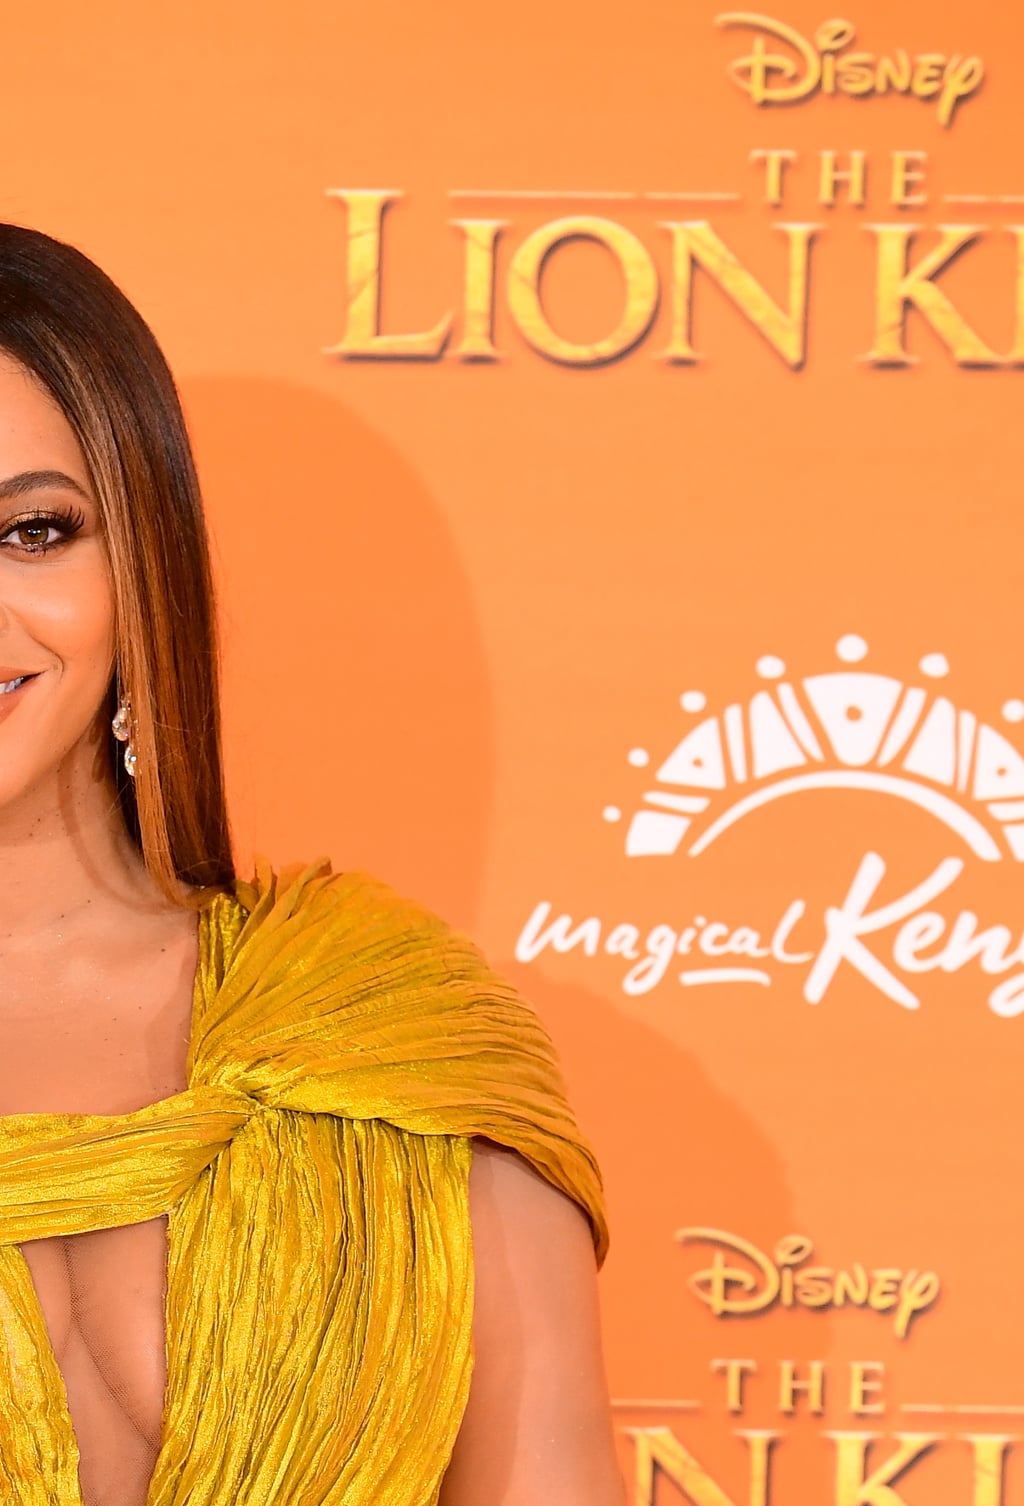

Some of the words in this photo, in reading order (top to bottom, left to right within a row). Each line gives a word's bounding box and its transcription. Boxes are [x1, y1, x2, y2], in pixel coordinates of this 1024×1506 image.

[749, 149, 928, 207] THE
[322, 189, 824, 371] LION
[711, 1360, 887, 1418] THE
